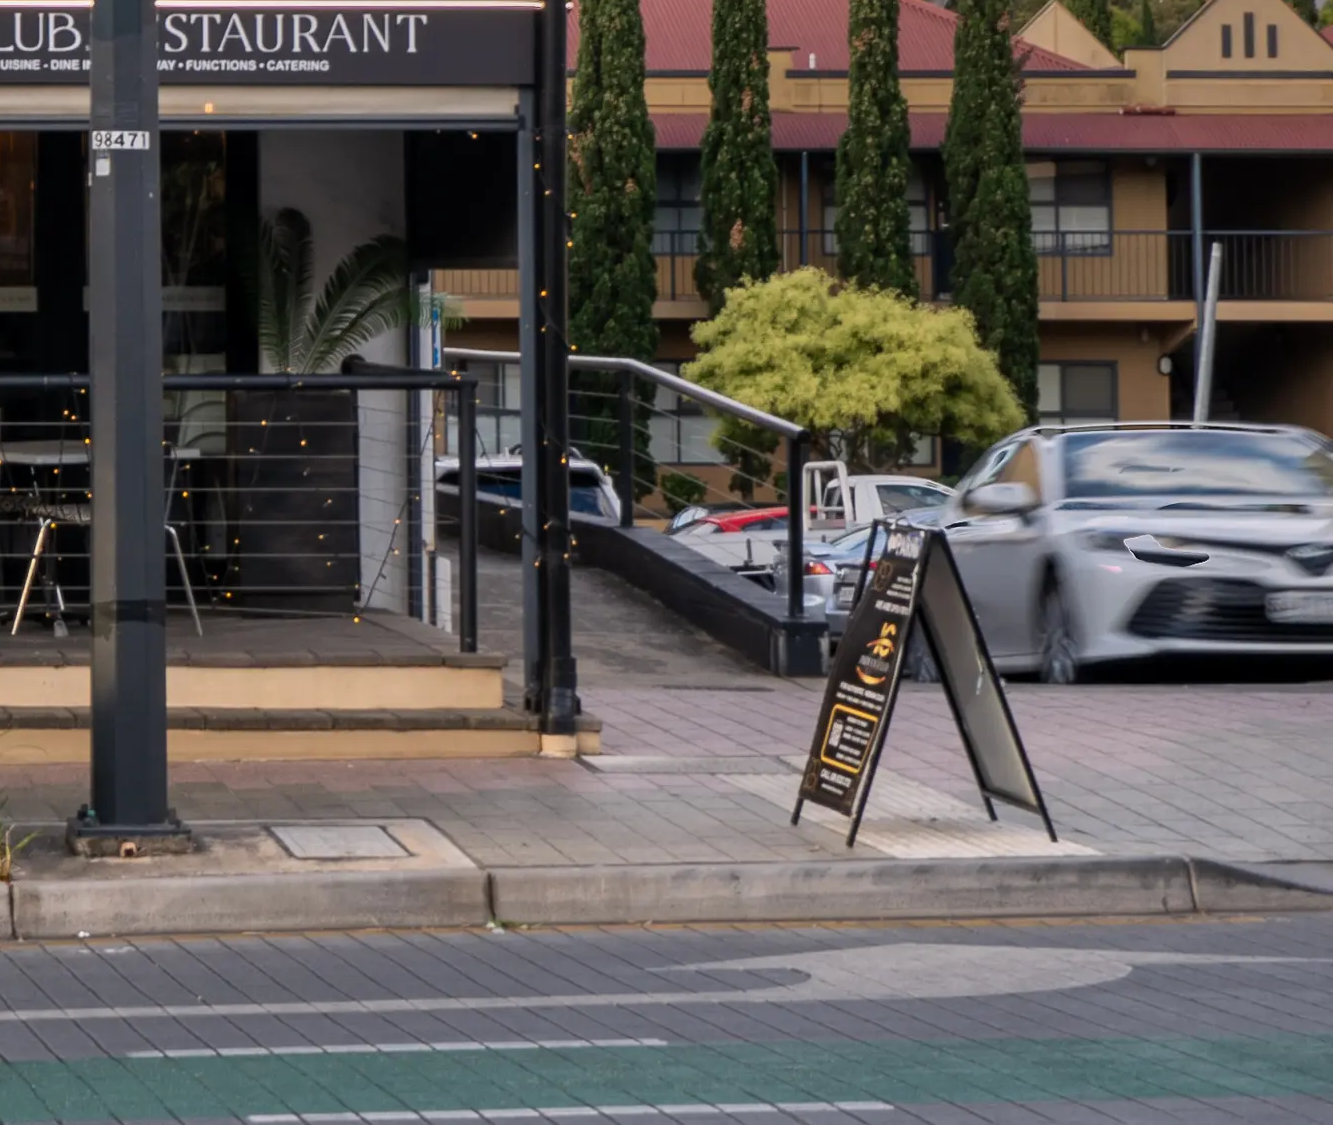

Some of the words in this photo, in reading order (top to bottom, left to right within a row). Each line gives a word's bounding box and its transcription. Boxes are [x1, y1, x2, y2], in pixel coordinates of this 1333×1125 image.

[155, 13, 429, 53] STAURANT
[50, 59, 80, 71] DINE
[156, 59, 177, 71] AY
[185, 59, 257, 71] FUNCTIONS
[266, 59, 330, 72] CATERING
[94, 132, 147, 147] 98471
